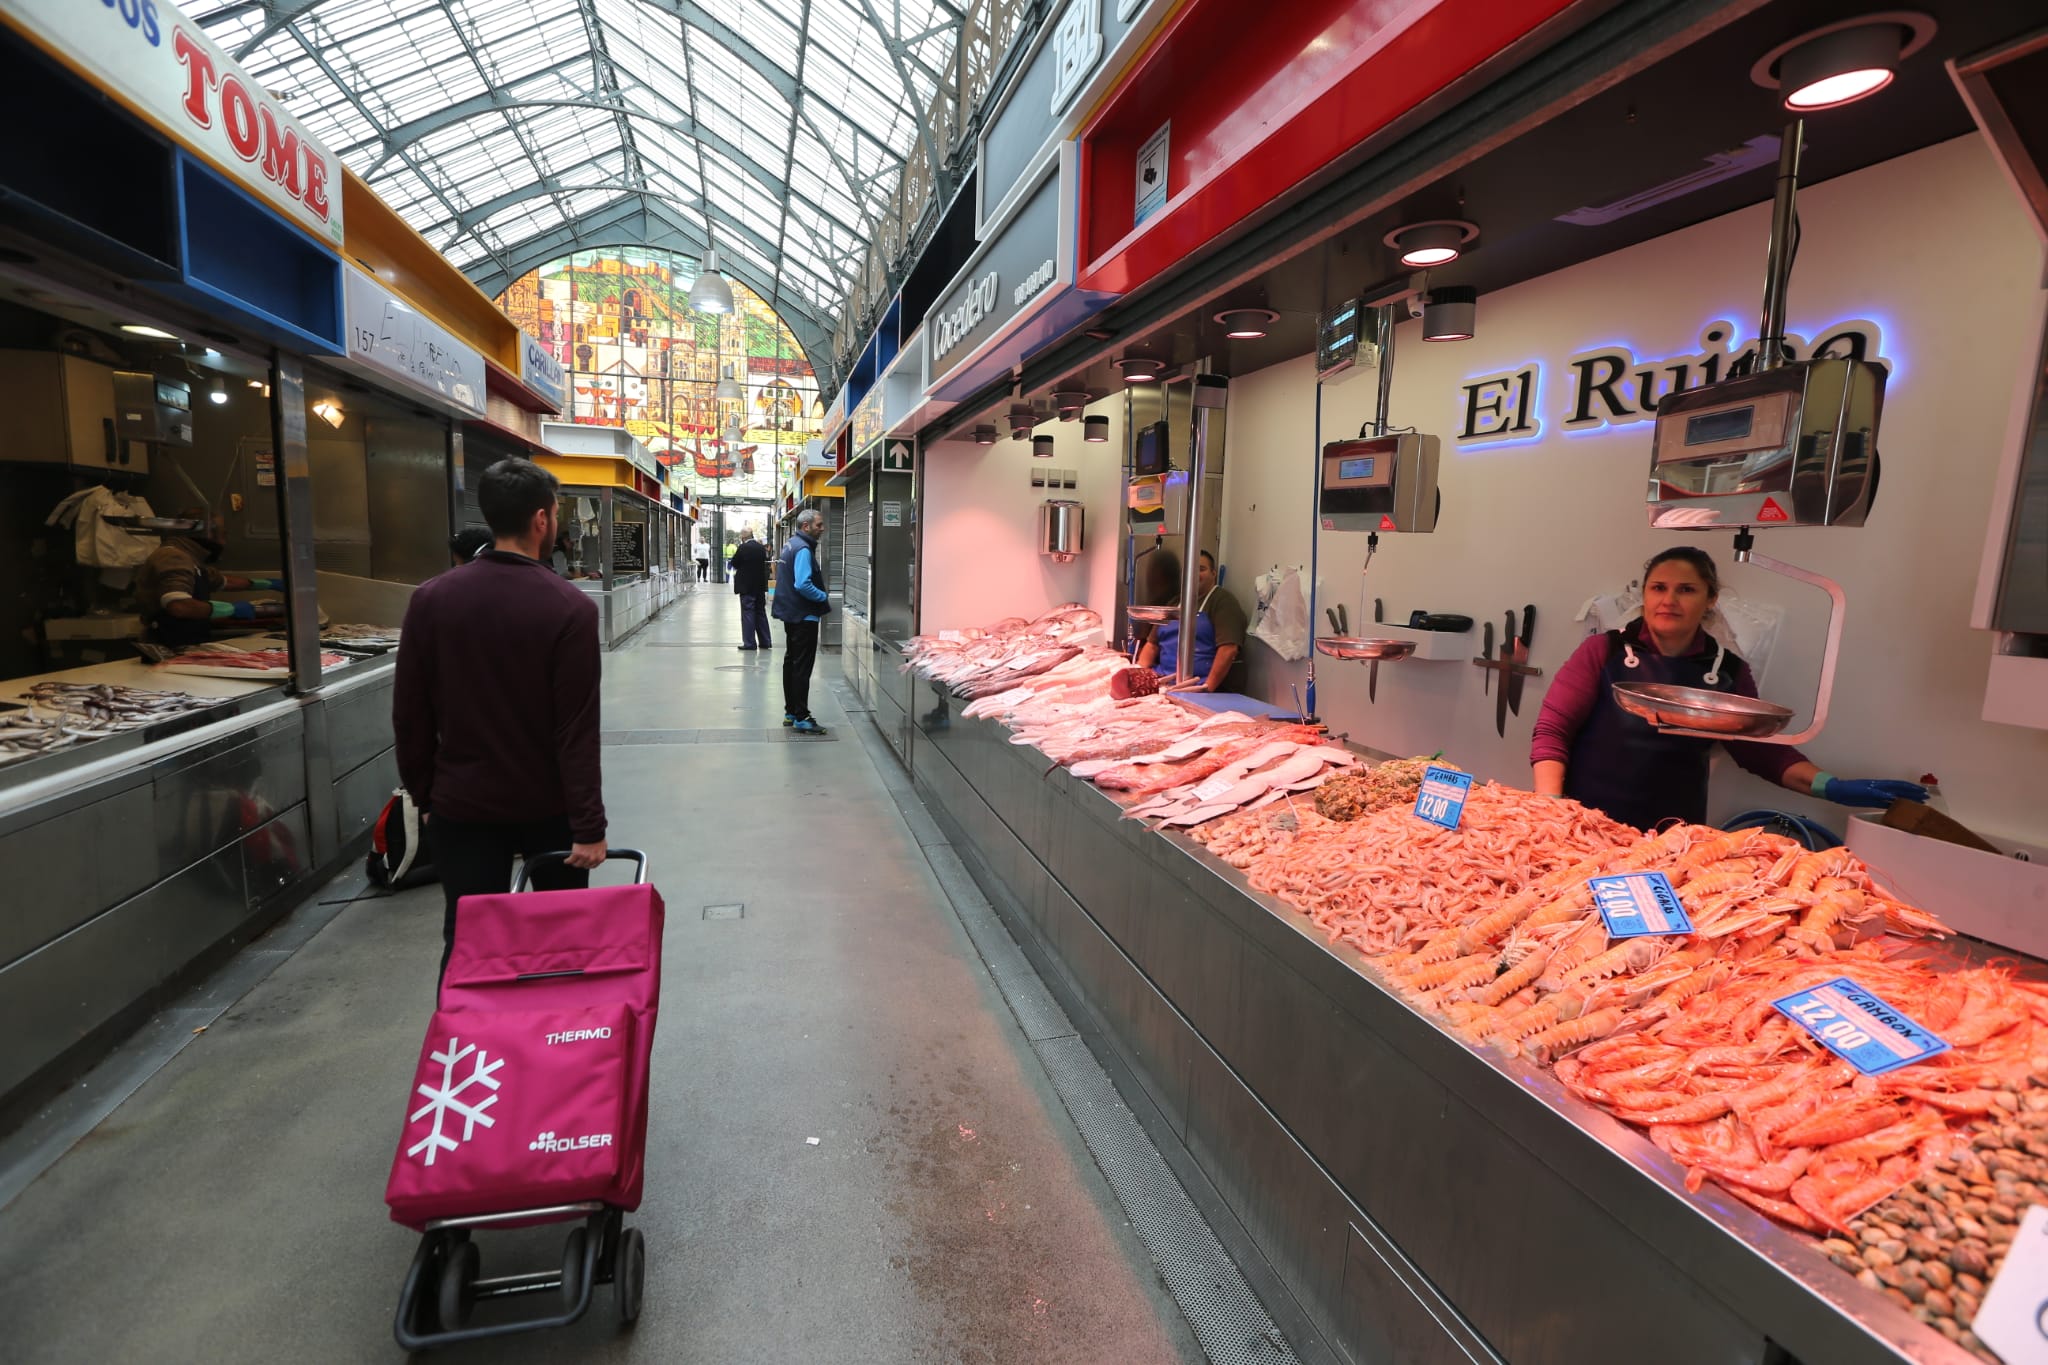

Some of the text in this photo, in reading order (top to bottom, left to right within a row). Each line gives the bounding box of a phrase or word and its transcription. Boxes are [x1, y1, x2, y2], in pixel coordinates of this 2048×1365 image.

[100, 0, 160, 47] OS
[171, 24, 329, 224] TOME
[354, 326, 375, 353] 157
[1458, 330, 1868, 440] El Ruia
[1434, 772, 1459, 785] GAMBAS
[1847, 993, 1921, 1038] GAMBON
[545, 1026, 612, 1045] THERMO
[544, 1133, 612, 1153] ROLSER
